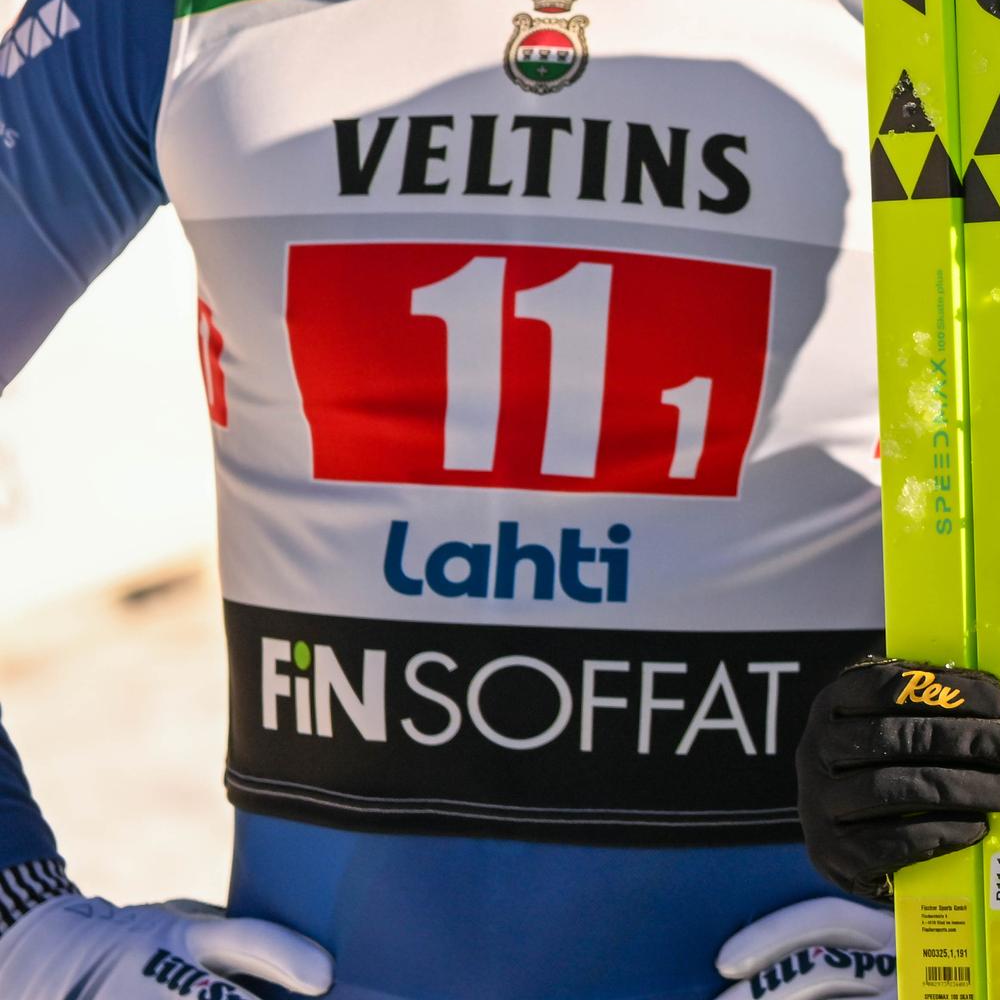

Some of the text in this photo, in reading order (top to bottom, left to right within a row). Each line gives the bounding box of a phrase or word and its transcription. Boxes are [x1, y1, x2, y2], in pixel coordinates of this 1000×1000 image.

[332, 113, 752, 215] VELTINS
[410, 255, 713, 480] 11 1
[382, 519, 632, 604] Lahti
[895, 670, 965, 709] Rex
